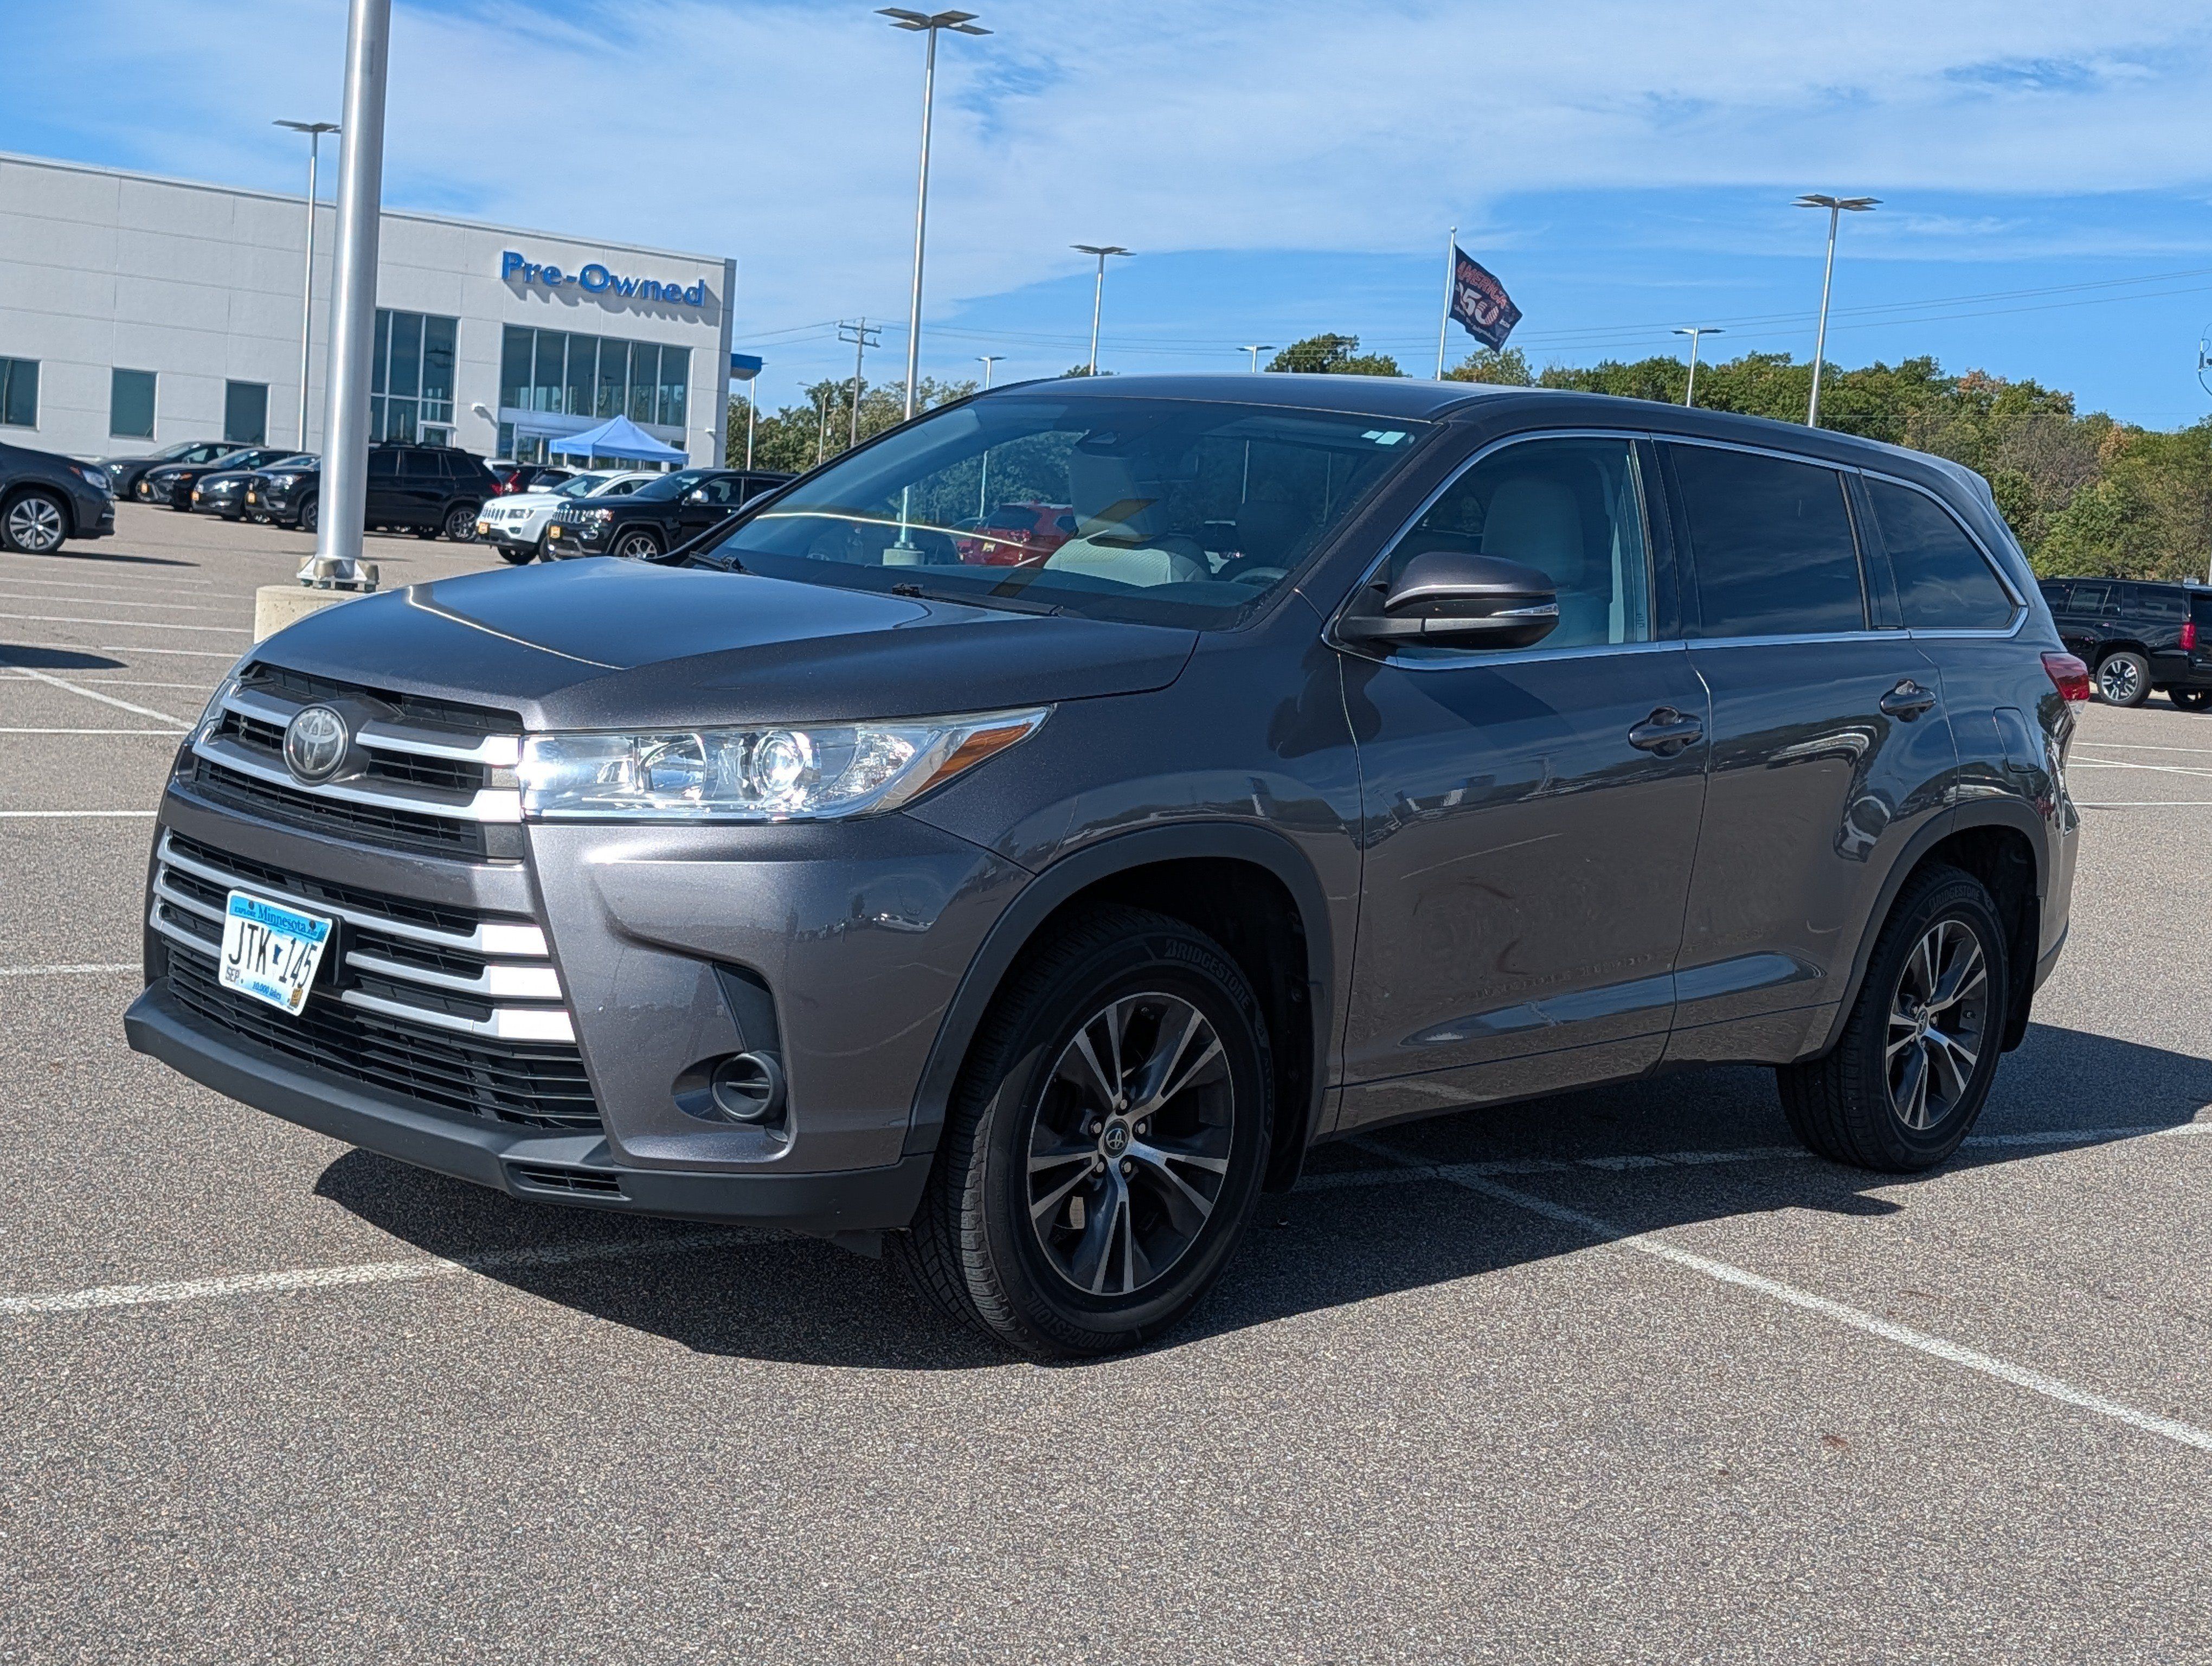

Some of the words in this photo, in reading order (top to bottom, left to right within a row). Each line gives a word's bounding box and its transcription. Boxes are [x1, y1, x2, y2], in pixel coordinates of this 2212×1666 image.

[502, 251, 705, 307] Pre-Owned
[258, 906, 306, 932] Minnesota
[226, 965, 241, 983] SEP
[228, 921, 272, 975] JTK
[279, 937, 318, 988] 145
[1164, 938, 1252, 1010] BRIDGESTONE
